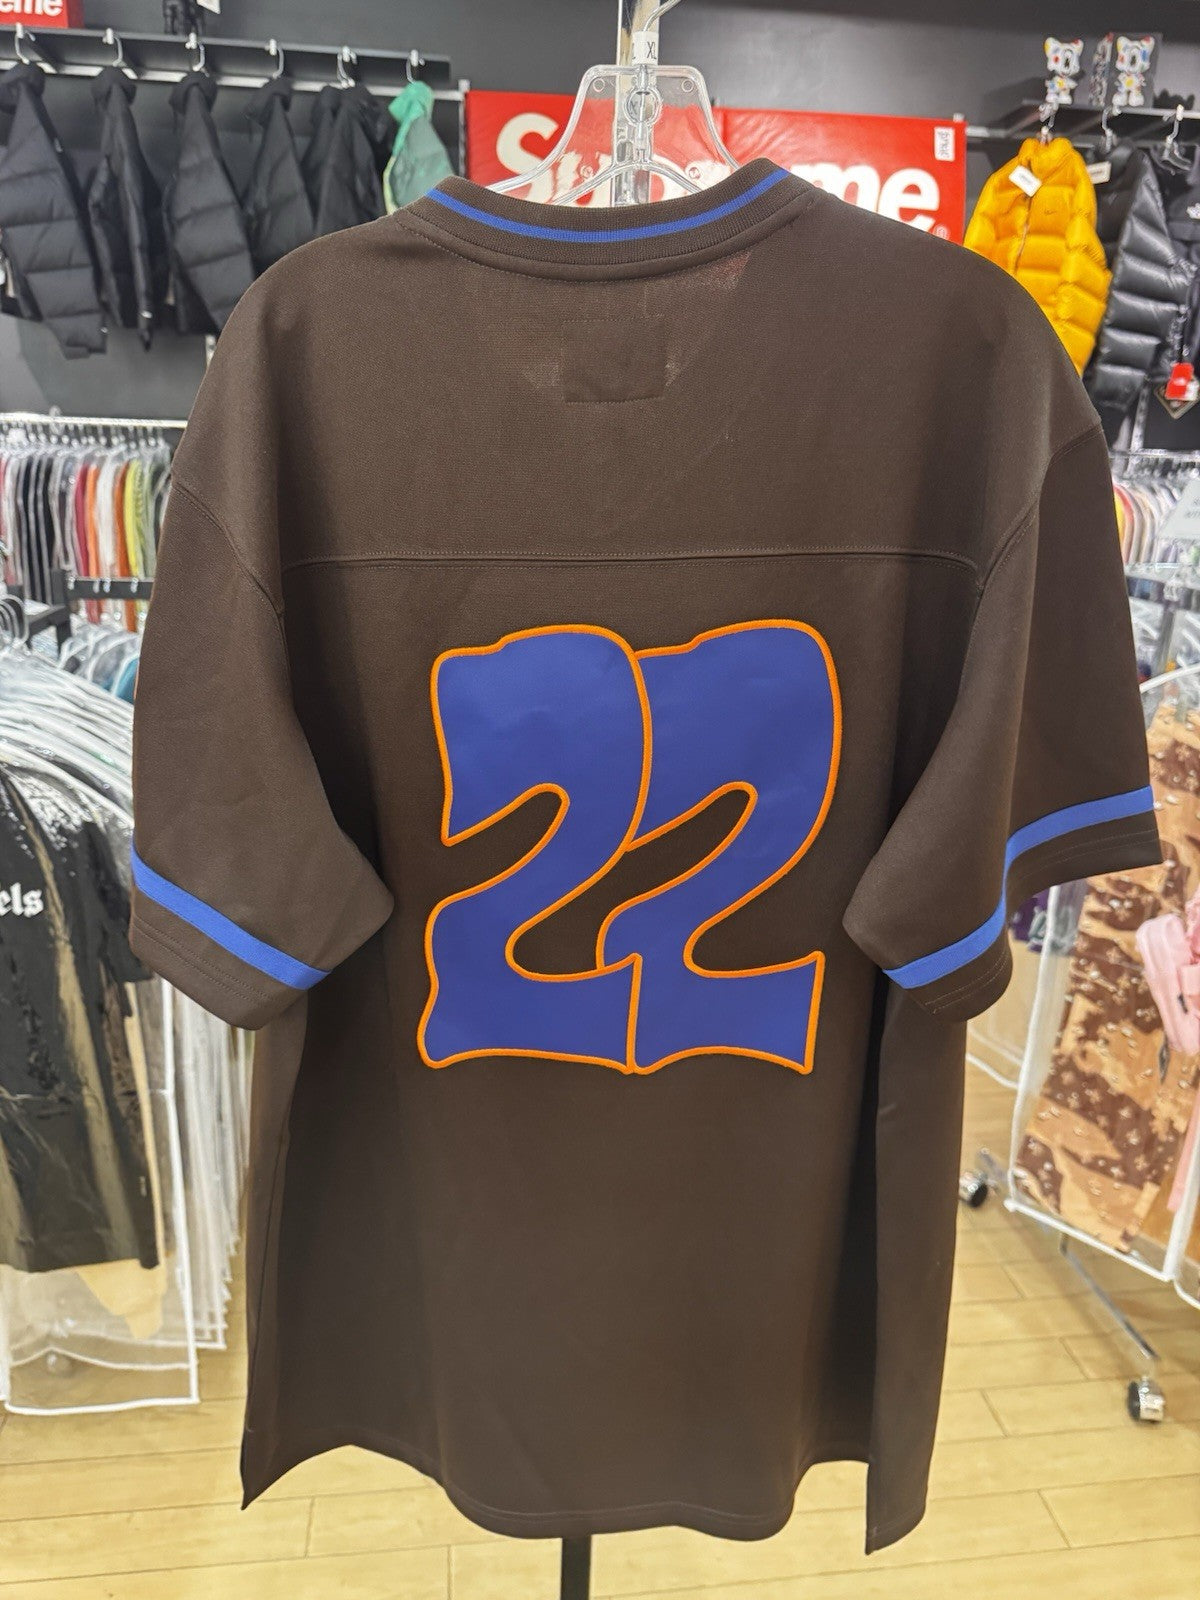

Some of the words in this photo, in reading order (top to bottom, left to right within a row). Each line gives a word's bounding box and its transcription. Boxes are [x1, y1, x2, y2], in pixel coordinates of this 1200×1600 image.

[646, 41, 657, 59] XL
[496, 112, 940, 233] Supme
[417, 619, 842, 1075] 22
